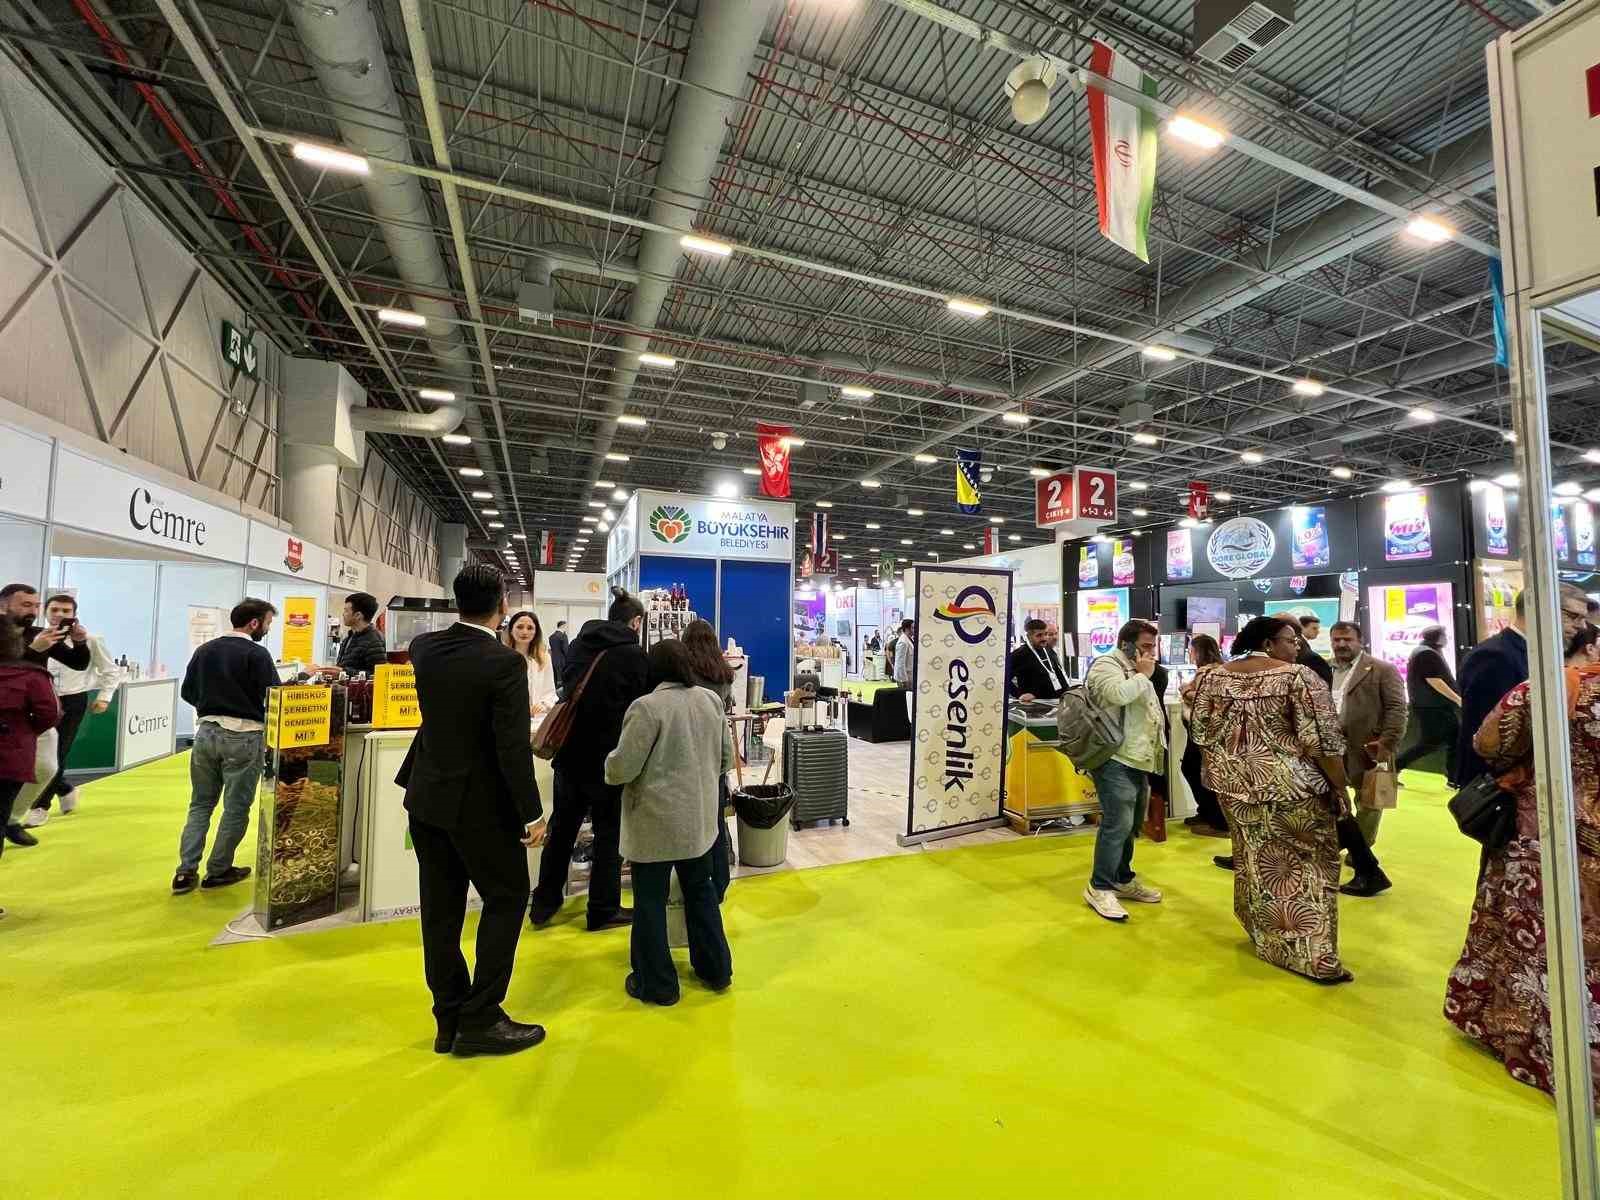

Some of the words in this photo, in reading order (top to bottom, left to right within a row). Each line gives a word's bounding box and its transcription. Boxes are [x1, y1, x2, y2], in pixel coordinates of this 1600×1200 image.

[1048, 480, 1062, 509] 2
[1090, 477, 1105, 506] 2
[129, 487, 206, 546] Cemre
[720, 511, 768, 523] MALATYA
[720, 537, 769, 550] BELEDİYESİ
[944, 658, 974, 793] esenlik
